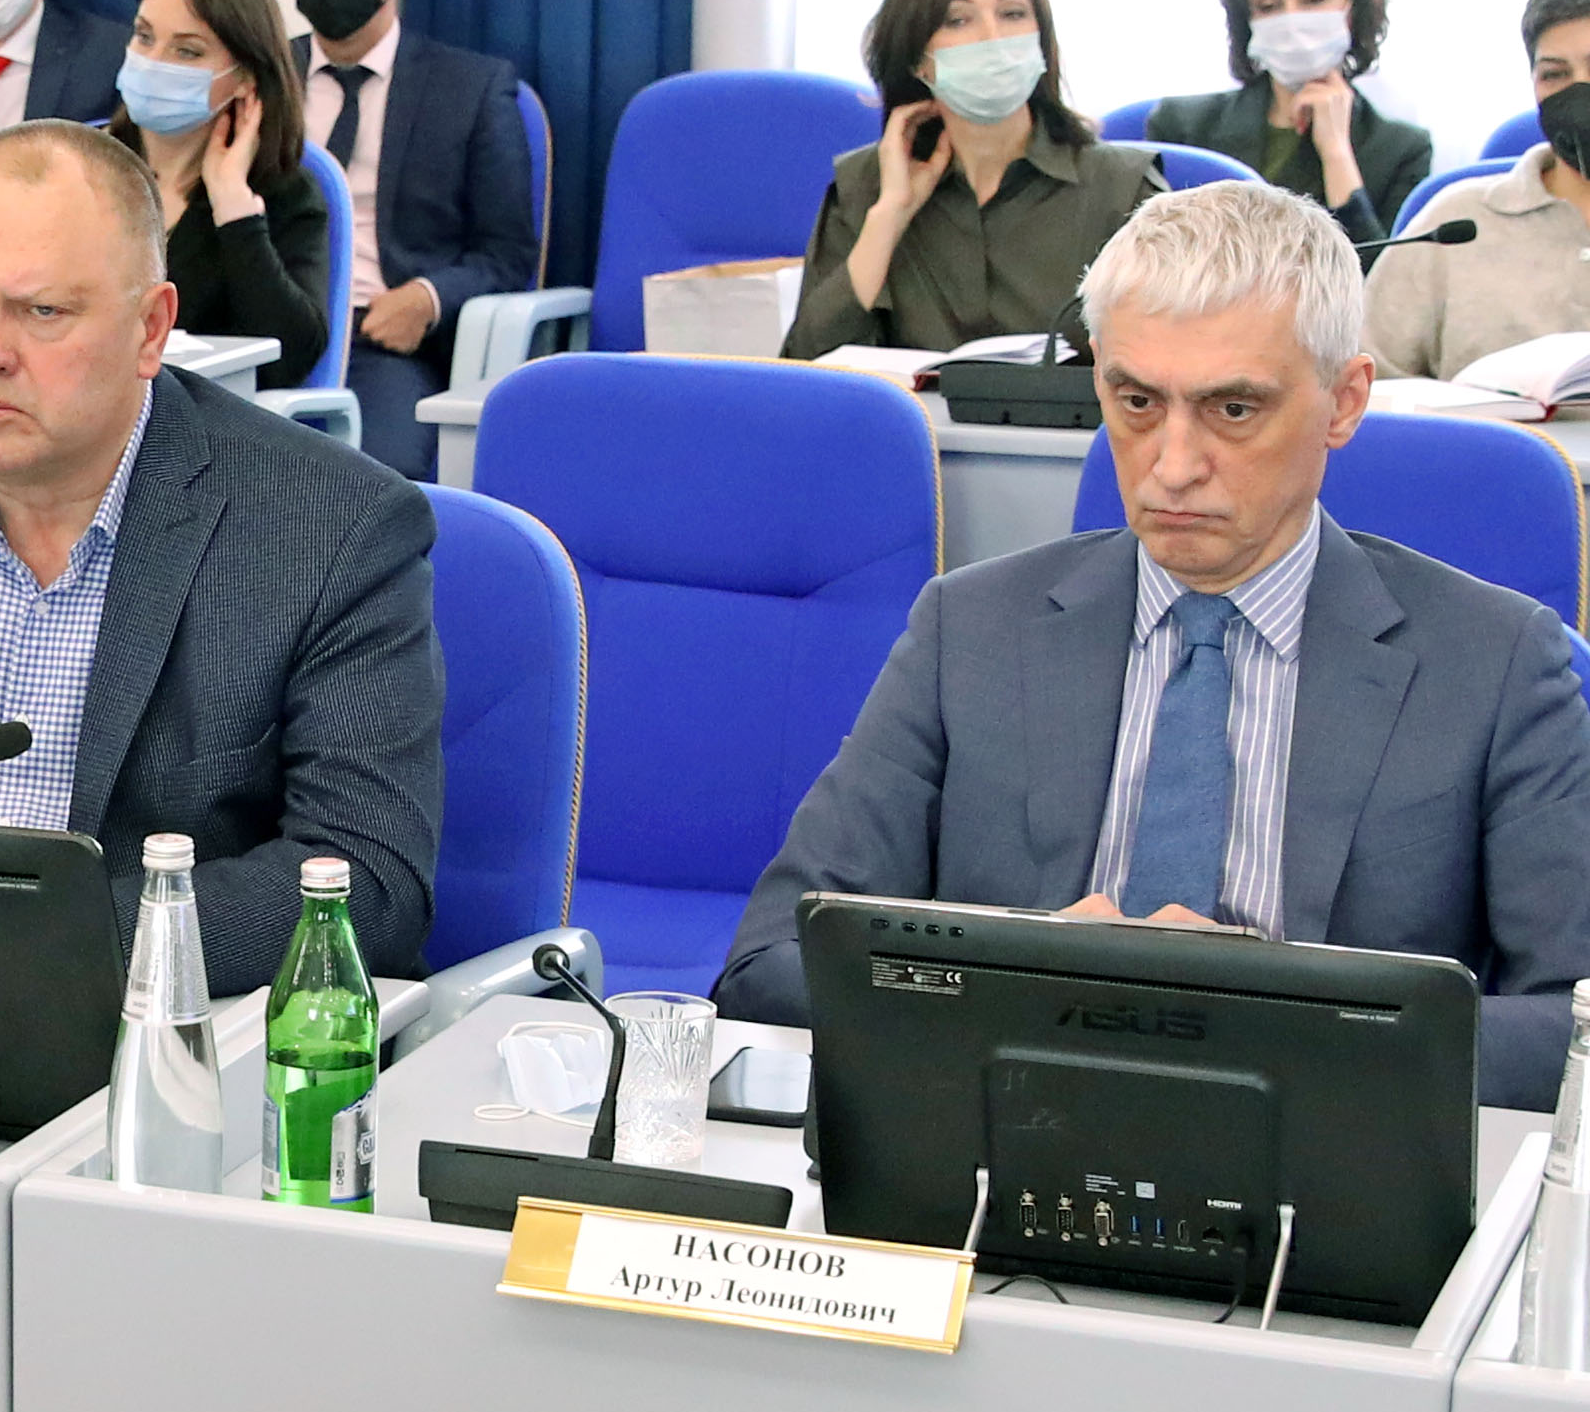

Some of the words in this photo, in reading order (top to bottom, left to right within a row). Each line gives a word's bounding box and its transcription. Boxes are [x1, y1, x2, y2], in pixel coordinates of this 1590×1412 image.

[672, 1233, 846, 1279] НАСОНОВ
[610, 1264, 703, 1302] Артур
[710, 1278, 897, 1324] Леонидович
